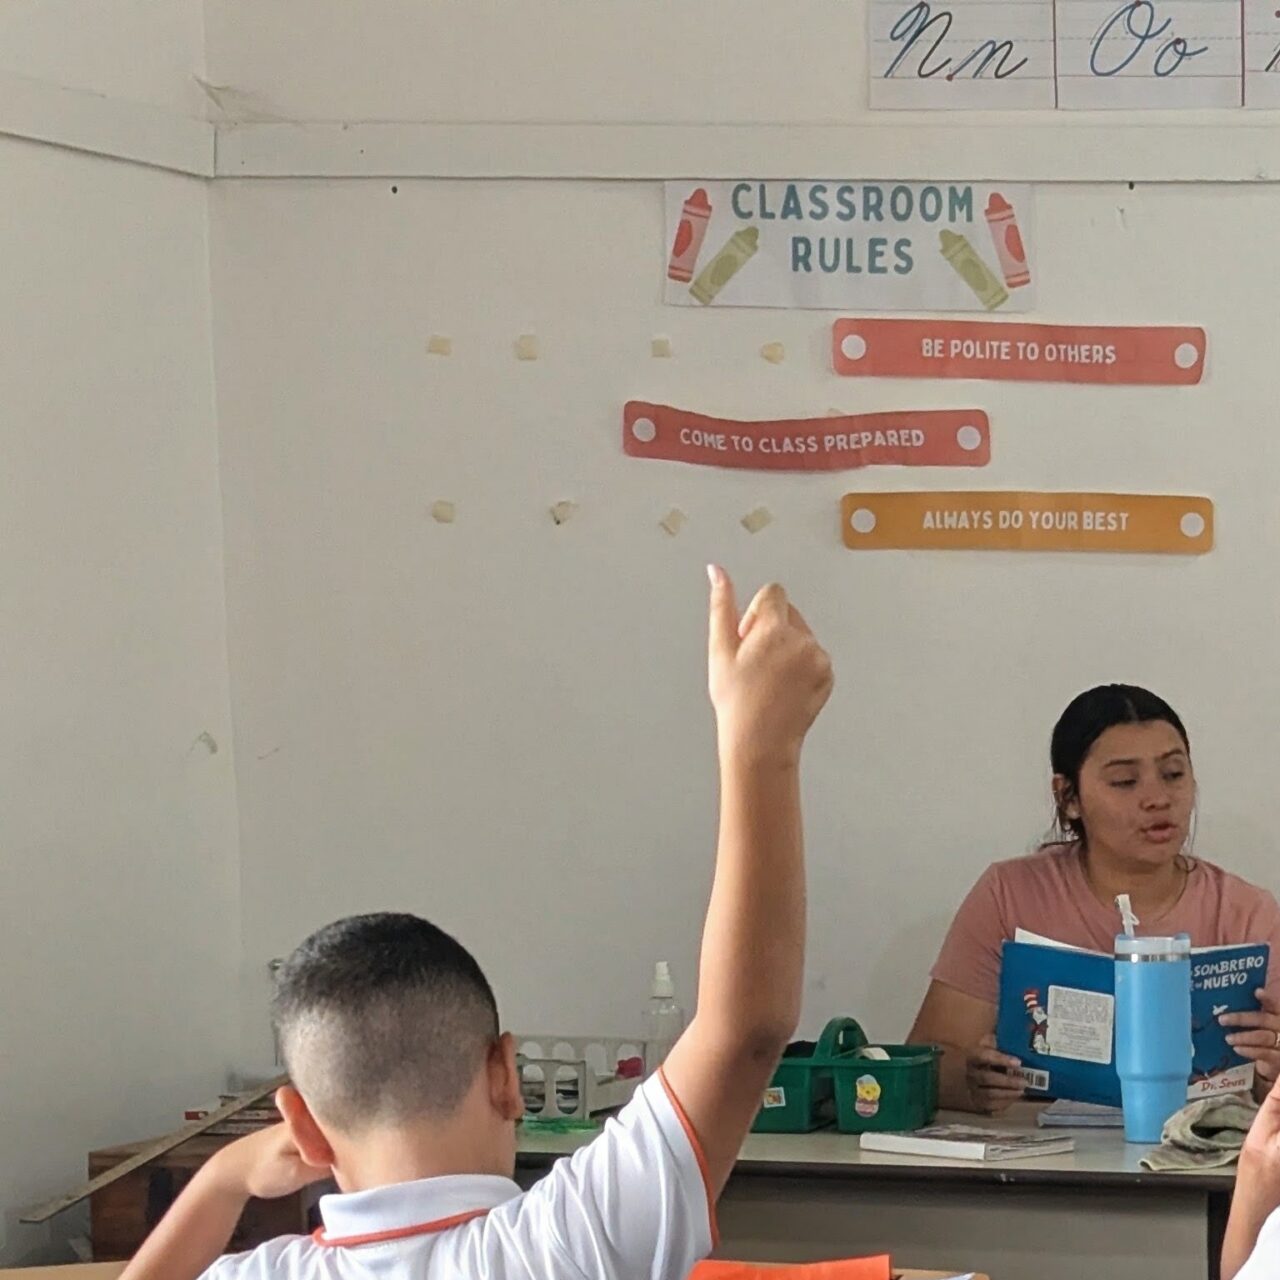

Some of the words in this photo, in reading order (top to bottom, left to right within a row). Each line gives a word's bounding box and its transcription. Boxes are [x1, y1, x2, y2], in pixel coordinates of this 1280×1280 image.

[884, 0, 1028, 80] Nn
[1090, 0, 1209, 77] Oo
[731, 182, 975, 223] CLASSROOM
[791, 235, 915, 275] RULES
[921, 337, 945, 358] BE
[950, 339, 1011, 360] POLITE
[1016, 341, 1040, 361] TO
[1044, 343, 1117, 364] OTHERS
[679, 427, 727, 450] COME
[730, 434, 753, 452] TO
[758, 435, 818, 453] CLASS
[823, 429, 925, 452] PREPARED
[923, 510, 993, 530] ALWAYS
[998, 510, 1023, 530] DO
[1028, 511, 1078, 531] YOUR
[1082, 511, 1130, 531] BEST
[1193, 955, 1265, 978] SOMBRERO
[1203, 972, 1248, 991] NUEVO
